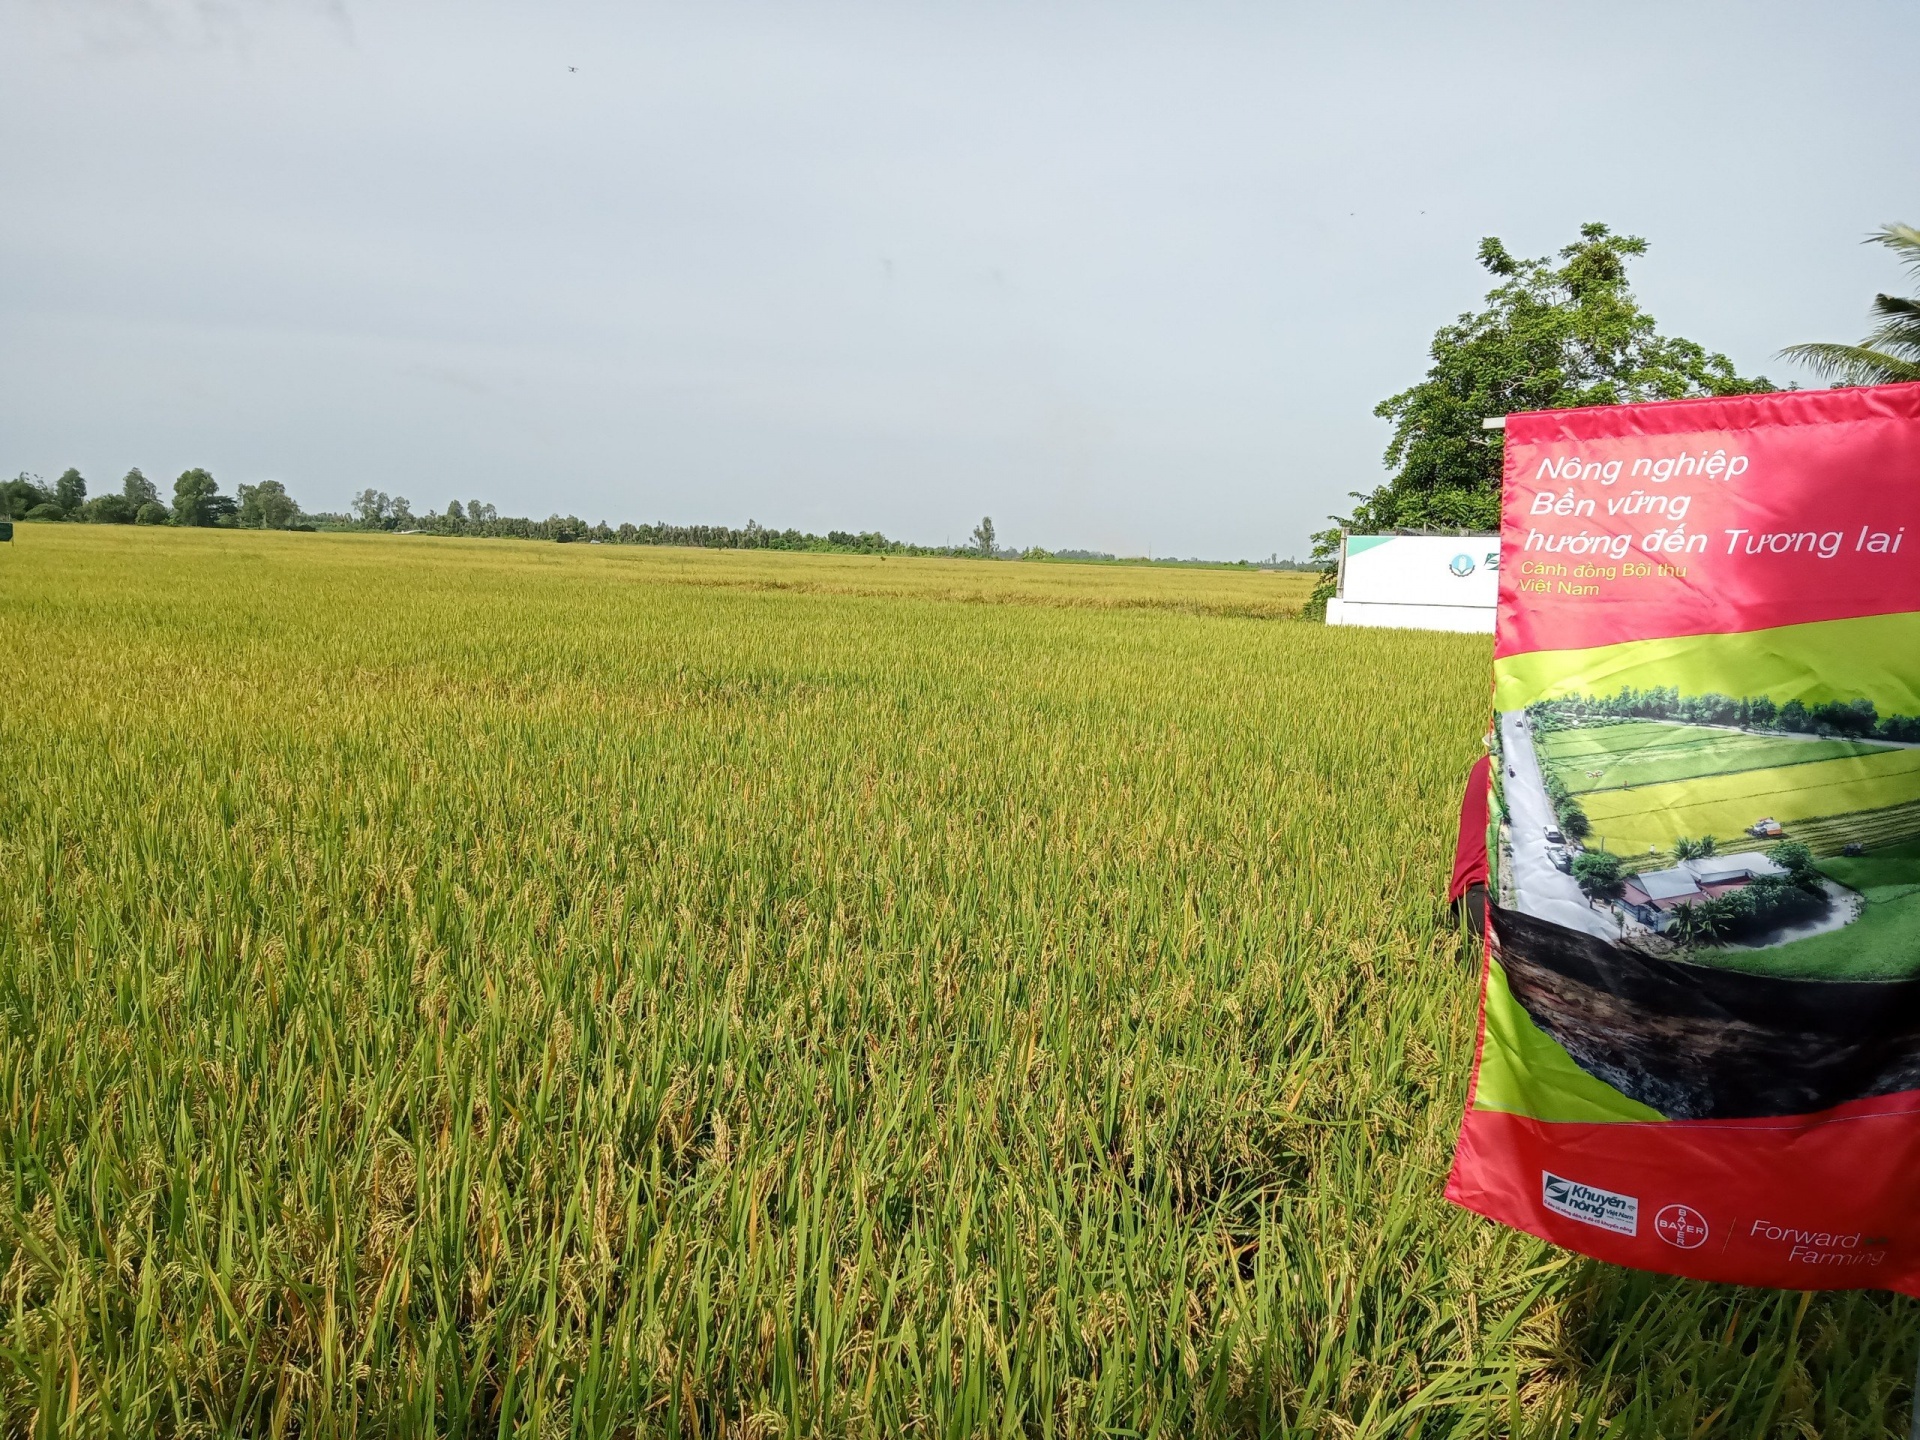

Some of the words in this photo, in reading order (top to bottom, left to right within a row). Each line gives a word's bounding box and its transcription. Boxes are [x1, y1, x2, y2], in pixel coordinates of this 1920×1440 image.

[1535, 456, 1624, 486] Nông
[1630, 449, 1750, 483] nghiệp
[1529, 487, 1597, 517] Bền
[1606, 489, 1692, 521] vững
[1523, 527, 1633, 560] hướng
[1641, 523, 1709, 554] đến
[1723, 528, 1844, 559] Tương
[1855, 525, 1906, 554] lai
[1521, 560, 1568, 577] Cánh
[1573, 561, 1618, 581] đồng
[1622, 562, 1652, 579] Bội
[1657, 563, 1688, 578] thu
[1519, 578, 1552, 595] Việt
[1557, 580, 1600, 596] Nam
[1568, 1198, 1606, 1218] nông
[1571, 1184, 1627, 1210] Khuyến
[1659, 1219, 1705, 1235] BAYER
[1677, 1208, 1687, 1246] BAYER
[1750, 1219, 1861, 1249] Forward
[1788, 1245, 1887, 1267] Farming
